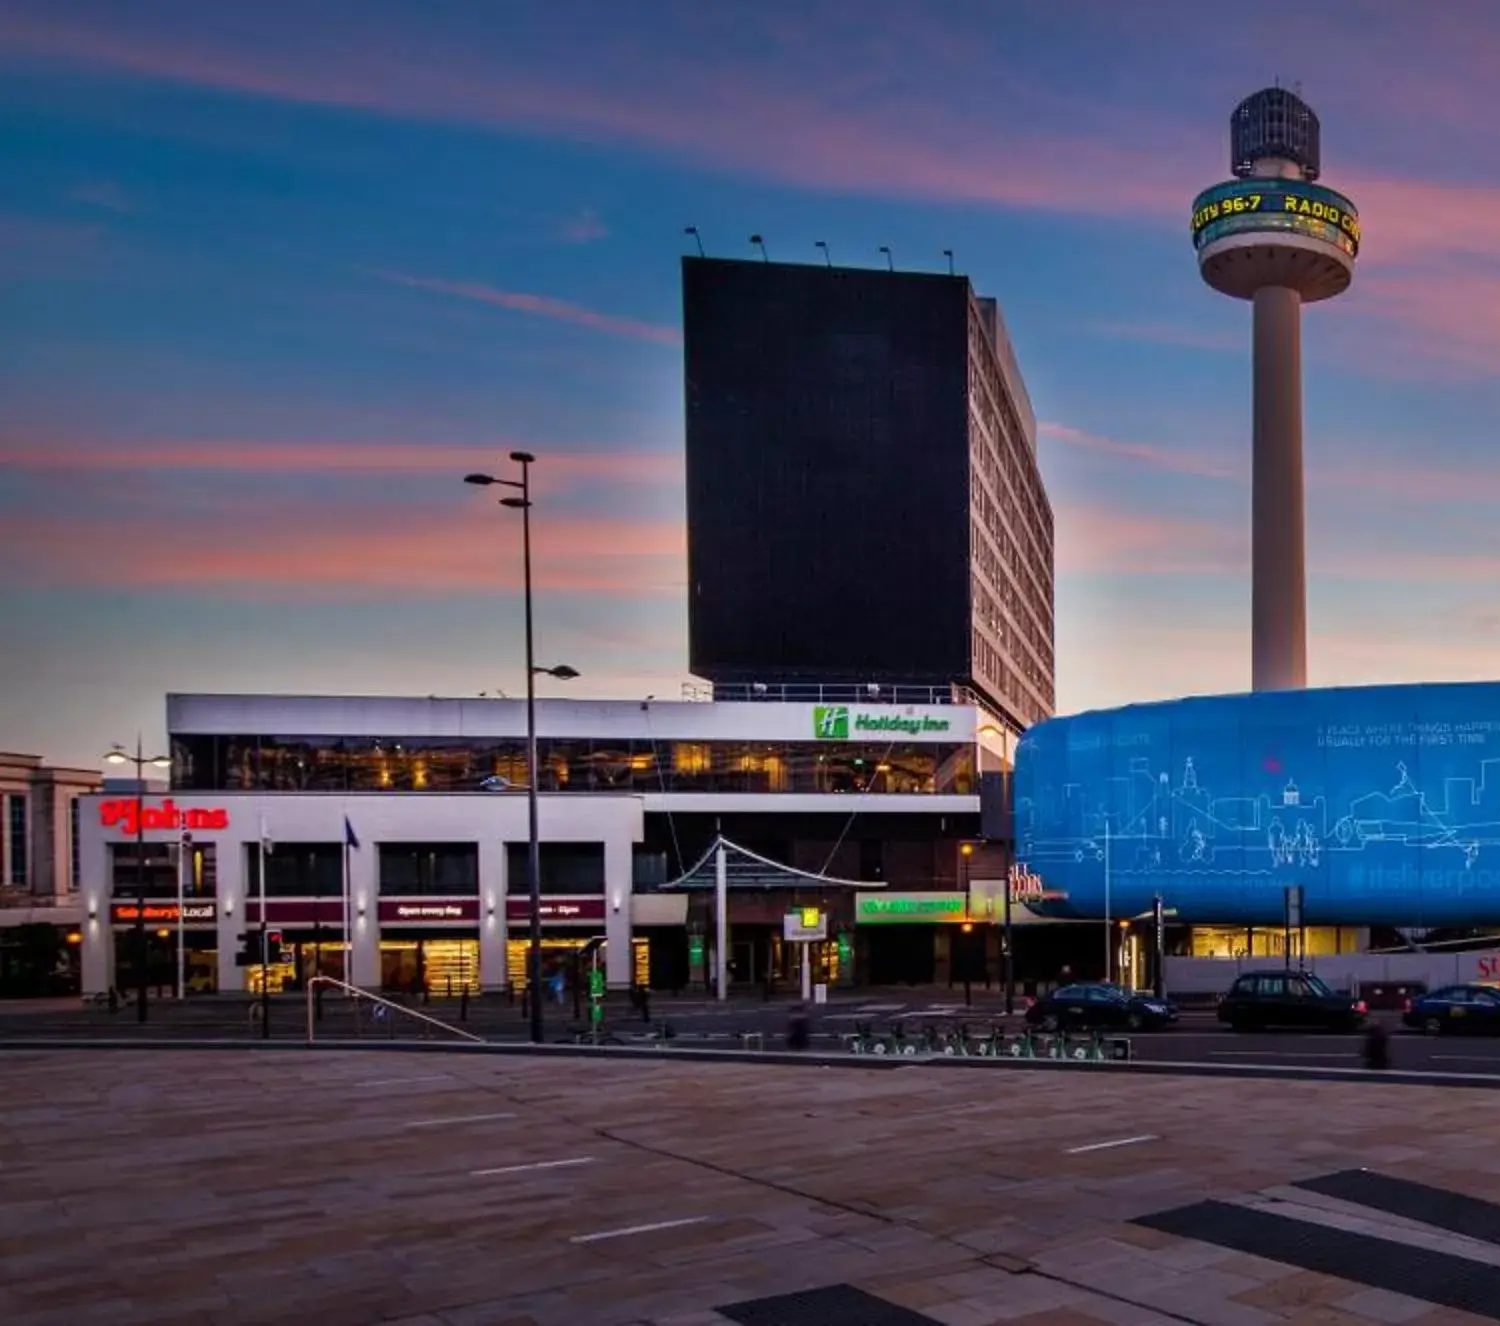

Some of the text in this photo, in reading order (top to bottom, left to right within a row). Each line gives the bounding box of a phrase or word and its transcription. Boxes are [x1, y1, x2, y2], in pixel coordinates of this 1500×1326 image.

[1285, 196, 1338, 222] RADIO
[855, 713, 950, 734] Holiday Inn
[183, 905, 214, 917] Local
[397, 907, 420, 917] Open
